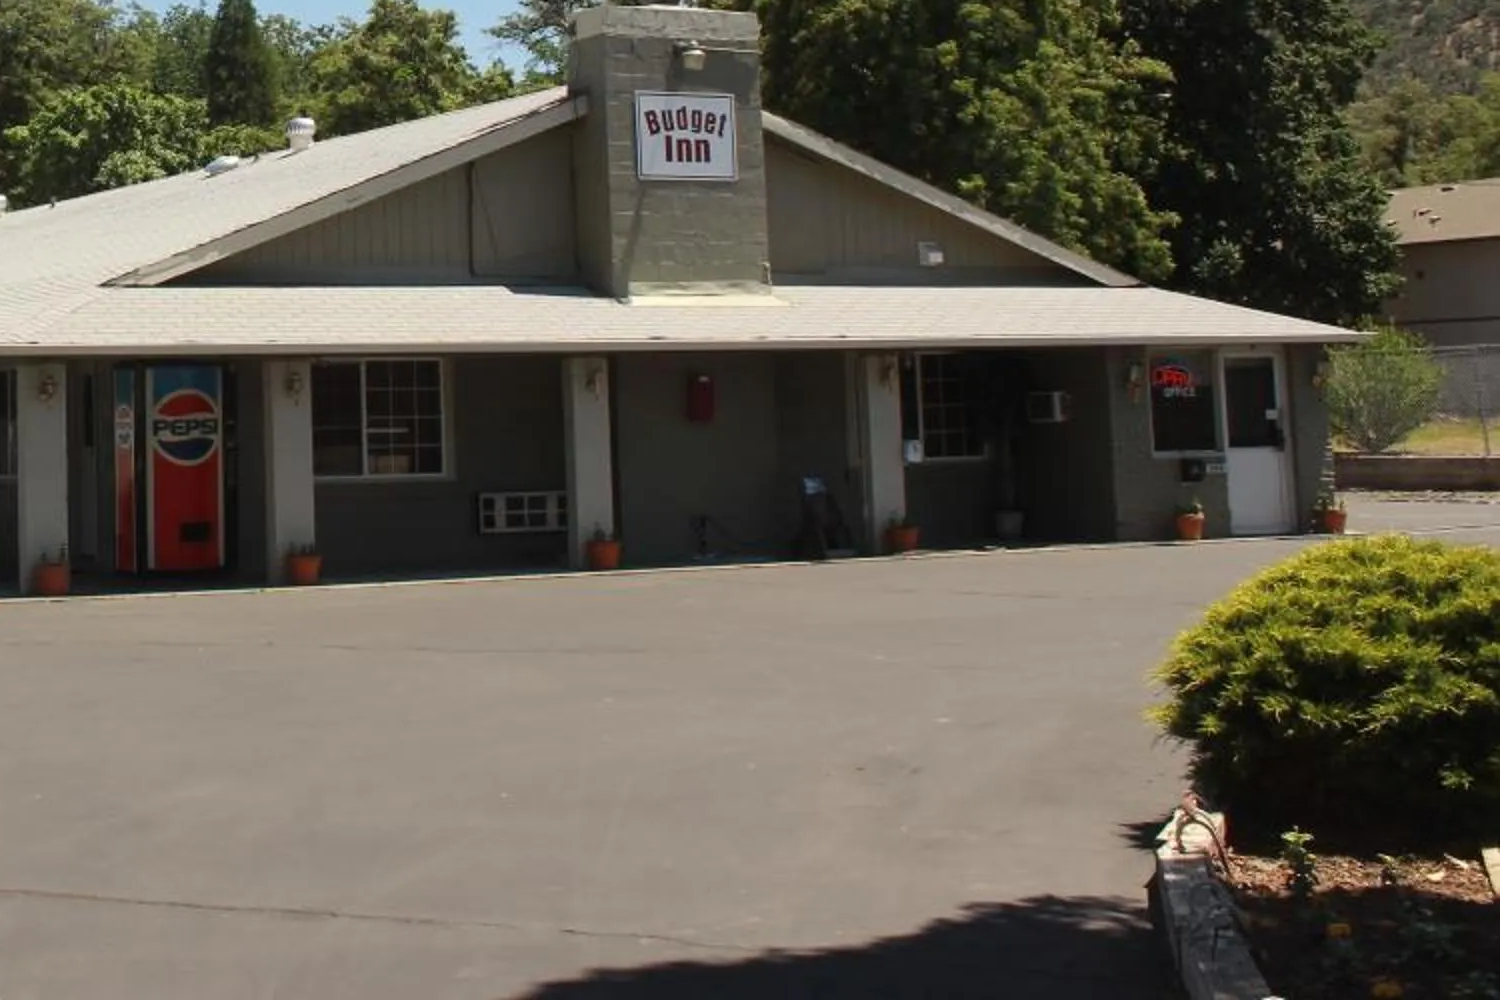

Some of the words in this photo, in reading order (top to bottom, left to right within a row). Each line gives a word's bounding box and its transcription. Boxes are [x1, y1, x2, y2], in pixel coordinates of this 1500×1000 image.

[644, 106, 727, 137] Budget
[665, 135, 711, 163] Inn
[153, 419, 218, 437] PEPSI
